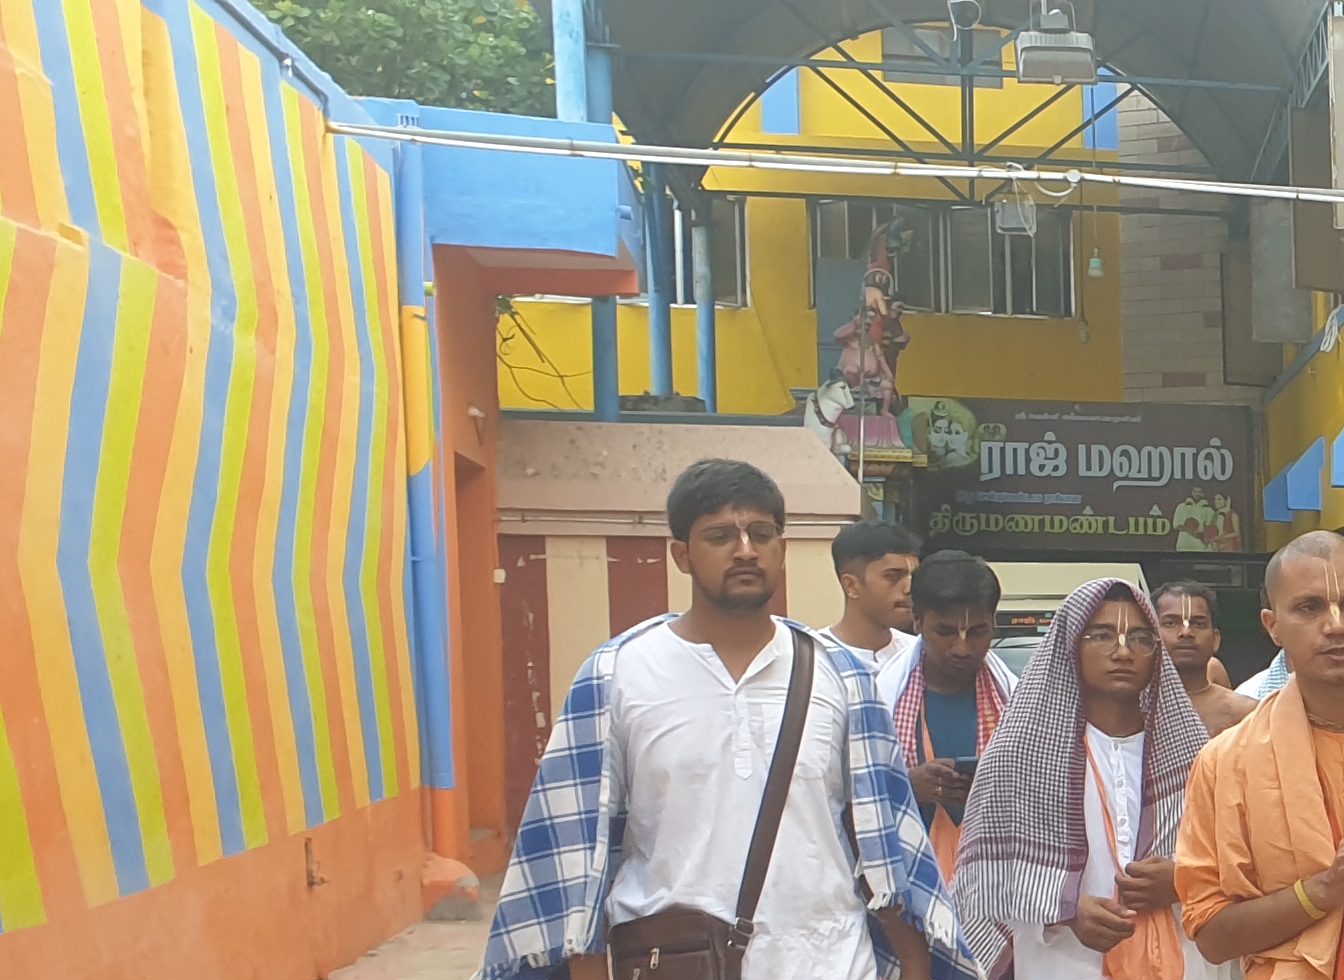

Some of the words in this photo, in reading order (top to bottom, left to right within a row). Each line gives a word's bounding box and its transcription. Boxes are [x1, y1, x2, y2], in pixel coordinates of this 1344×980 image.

[979, 431, 1067, 482] ராஜ்
[1077, 437, 1234, 492] மஹால்
[929, 504, 1171, 538] திருமணமண்டபம்
